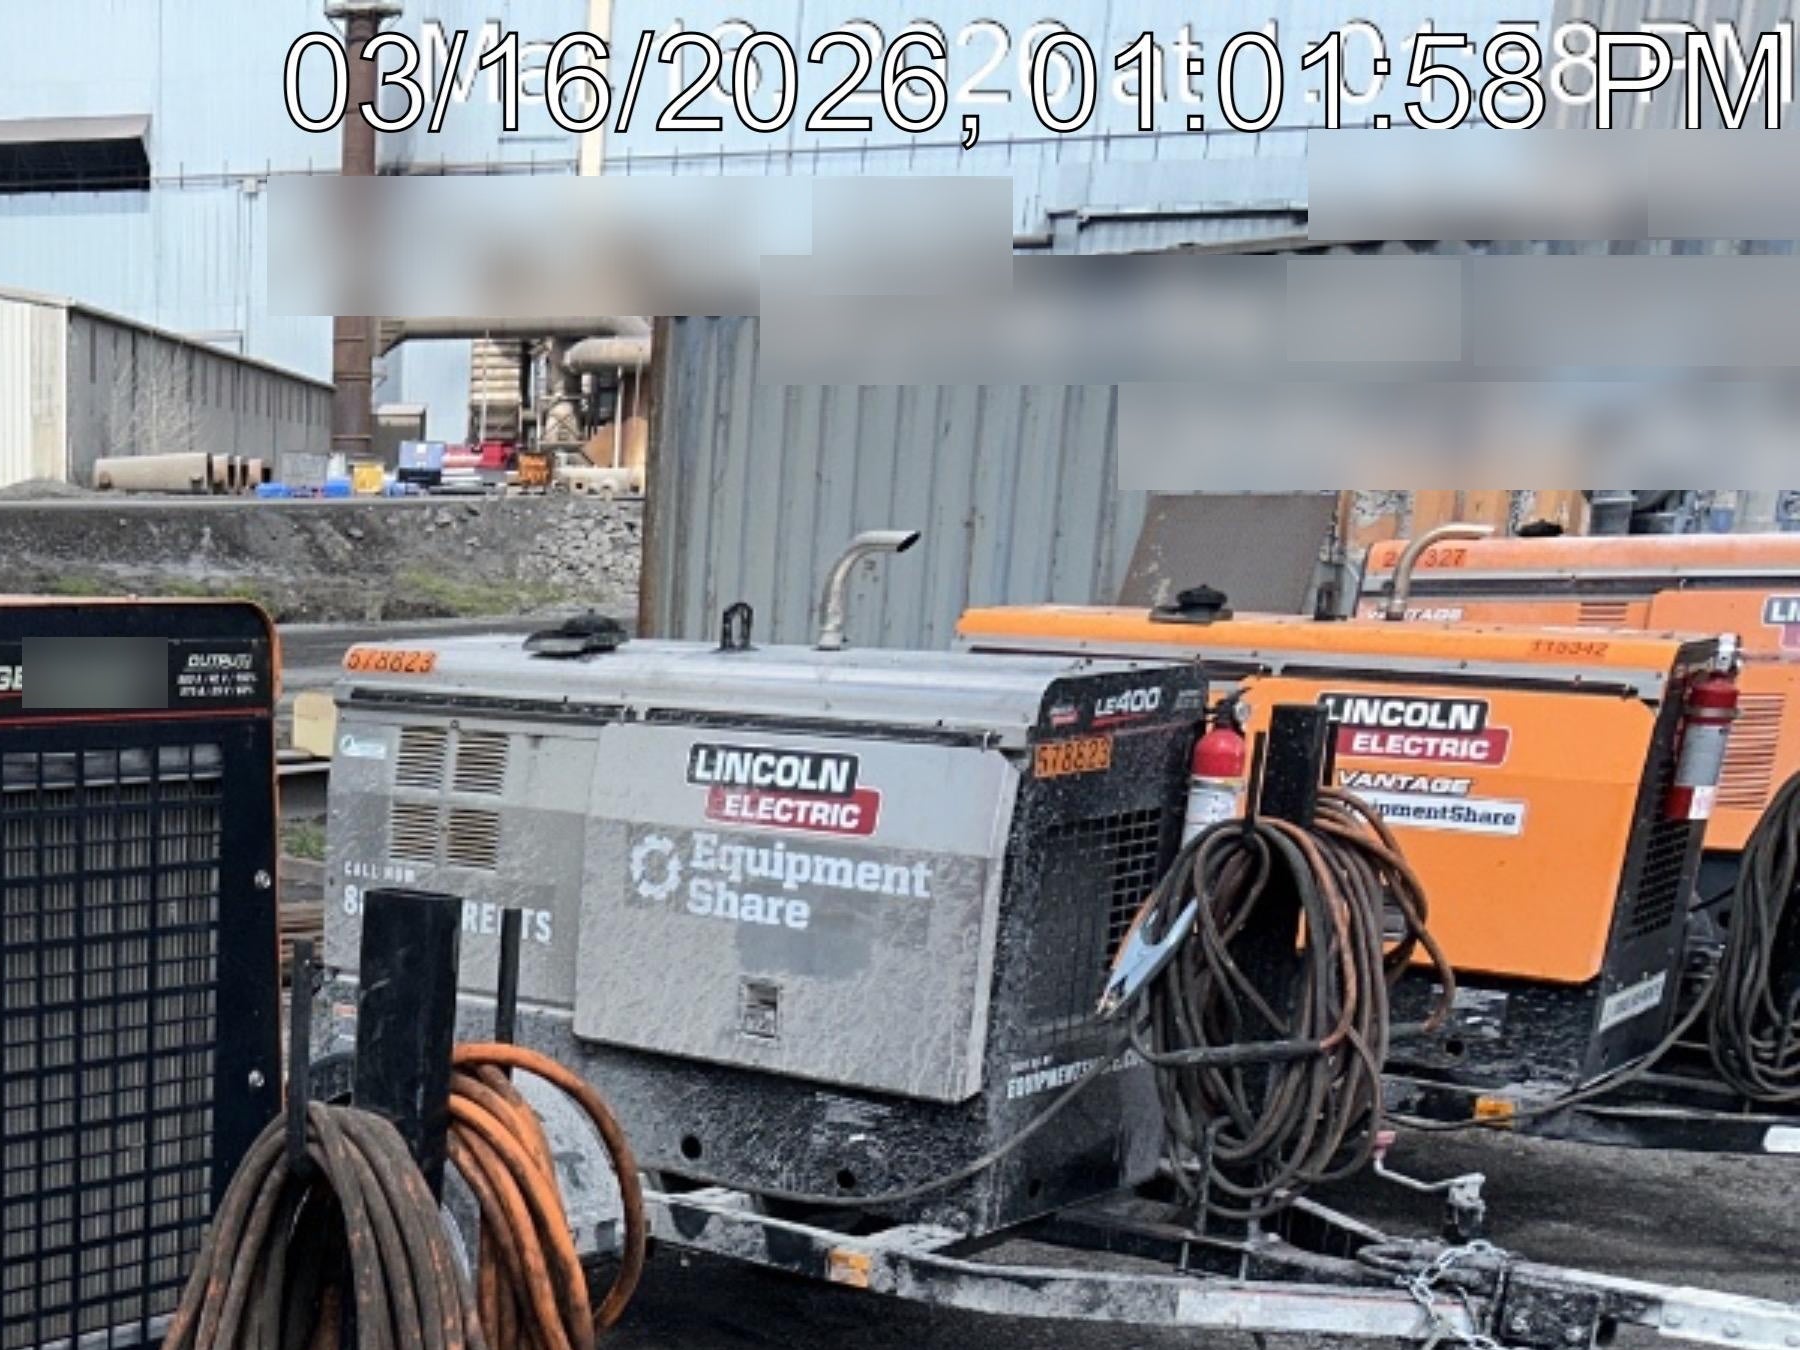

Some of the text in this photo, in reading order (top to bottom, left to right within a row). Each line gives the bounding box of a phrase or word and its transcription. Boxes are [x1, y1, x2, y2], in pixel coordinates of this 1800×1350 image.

[1325, 697, 1480, 730] LINCOLN
[1351, 733, 1491, 761] ELECTRIC
[695, 749, 851, 793] LINCOLN
[1338, 770, 1472, 794] VANTAGE
[723, 794, 861, 830] ELECTRIC
[689, 831, 934, 898] Equipment
[687, 879, 810, 929] Share
